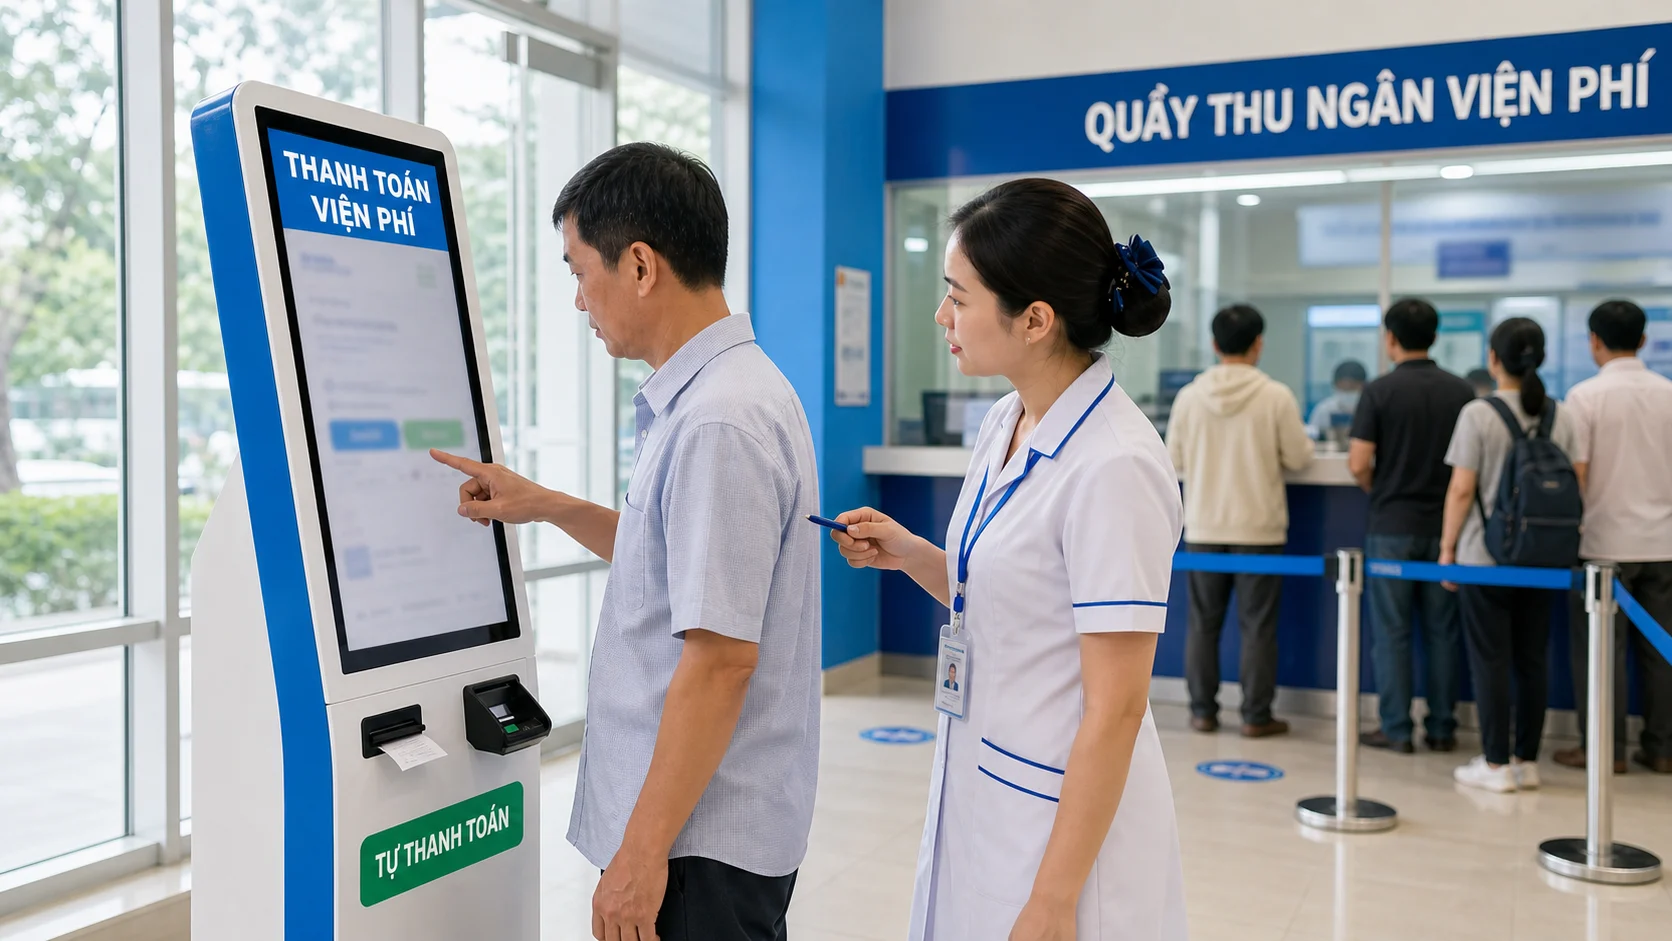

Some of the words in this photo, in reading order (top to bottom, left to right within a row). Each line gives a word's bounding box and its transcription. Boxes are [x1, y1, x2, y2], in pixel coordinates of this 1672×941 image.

[1206, 88, 1293, 137] THU
[1307, 68, 1434, 130] NGÂN
[1446, 60, 1553, 128] VIỆN
[1568, 47, 1657, 113] PHÍ
[283, 150, 369, 192] THANH
[372, 169, 432, 204] TOÁN
[310, 193, 371, 233] VIỆN
[376, 205, 416, 237] PHÍ
[375, 843, 401, 879] TỰ
[403, 823, 462, 867] THANH
[465, 803, 510, 842] TOÁN
